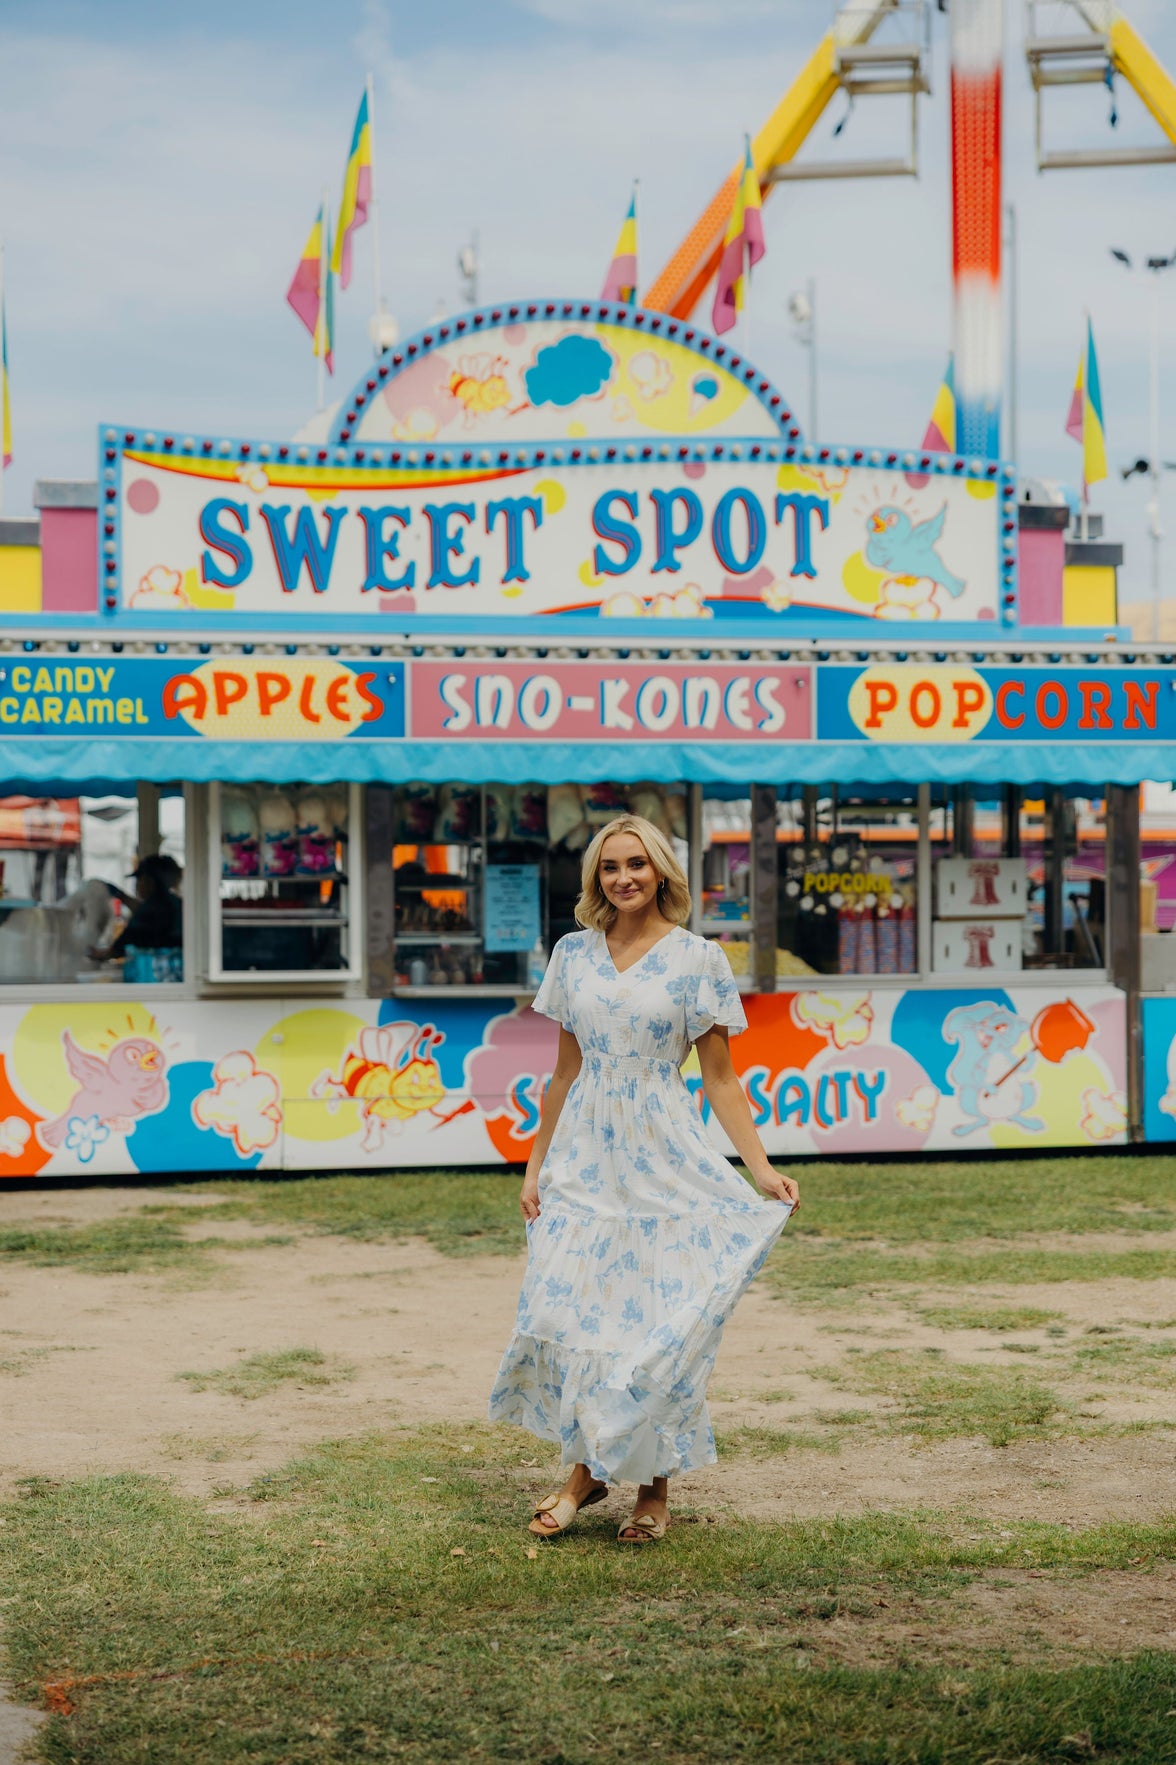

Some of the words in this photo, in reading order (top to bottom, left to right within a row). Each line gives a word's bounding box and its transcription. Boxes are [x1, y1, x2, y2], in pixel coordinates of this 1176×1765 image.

[199, 496, 543, 593] SWEET
[592, 487, 830, 578] SPOT
[162, 672, 386, 723] APPLES
[863, 679, 1160, 731] POPCORN
[803, 873, 892, 893] POPCORN
[746, 1070, 885, 1129] SALTY
